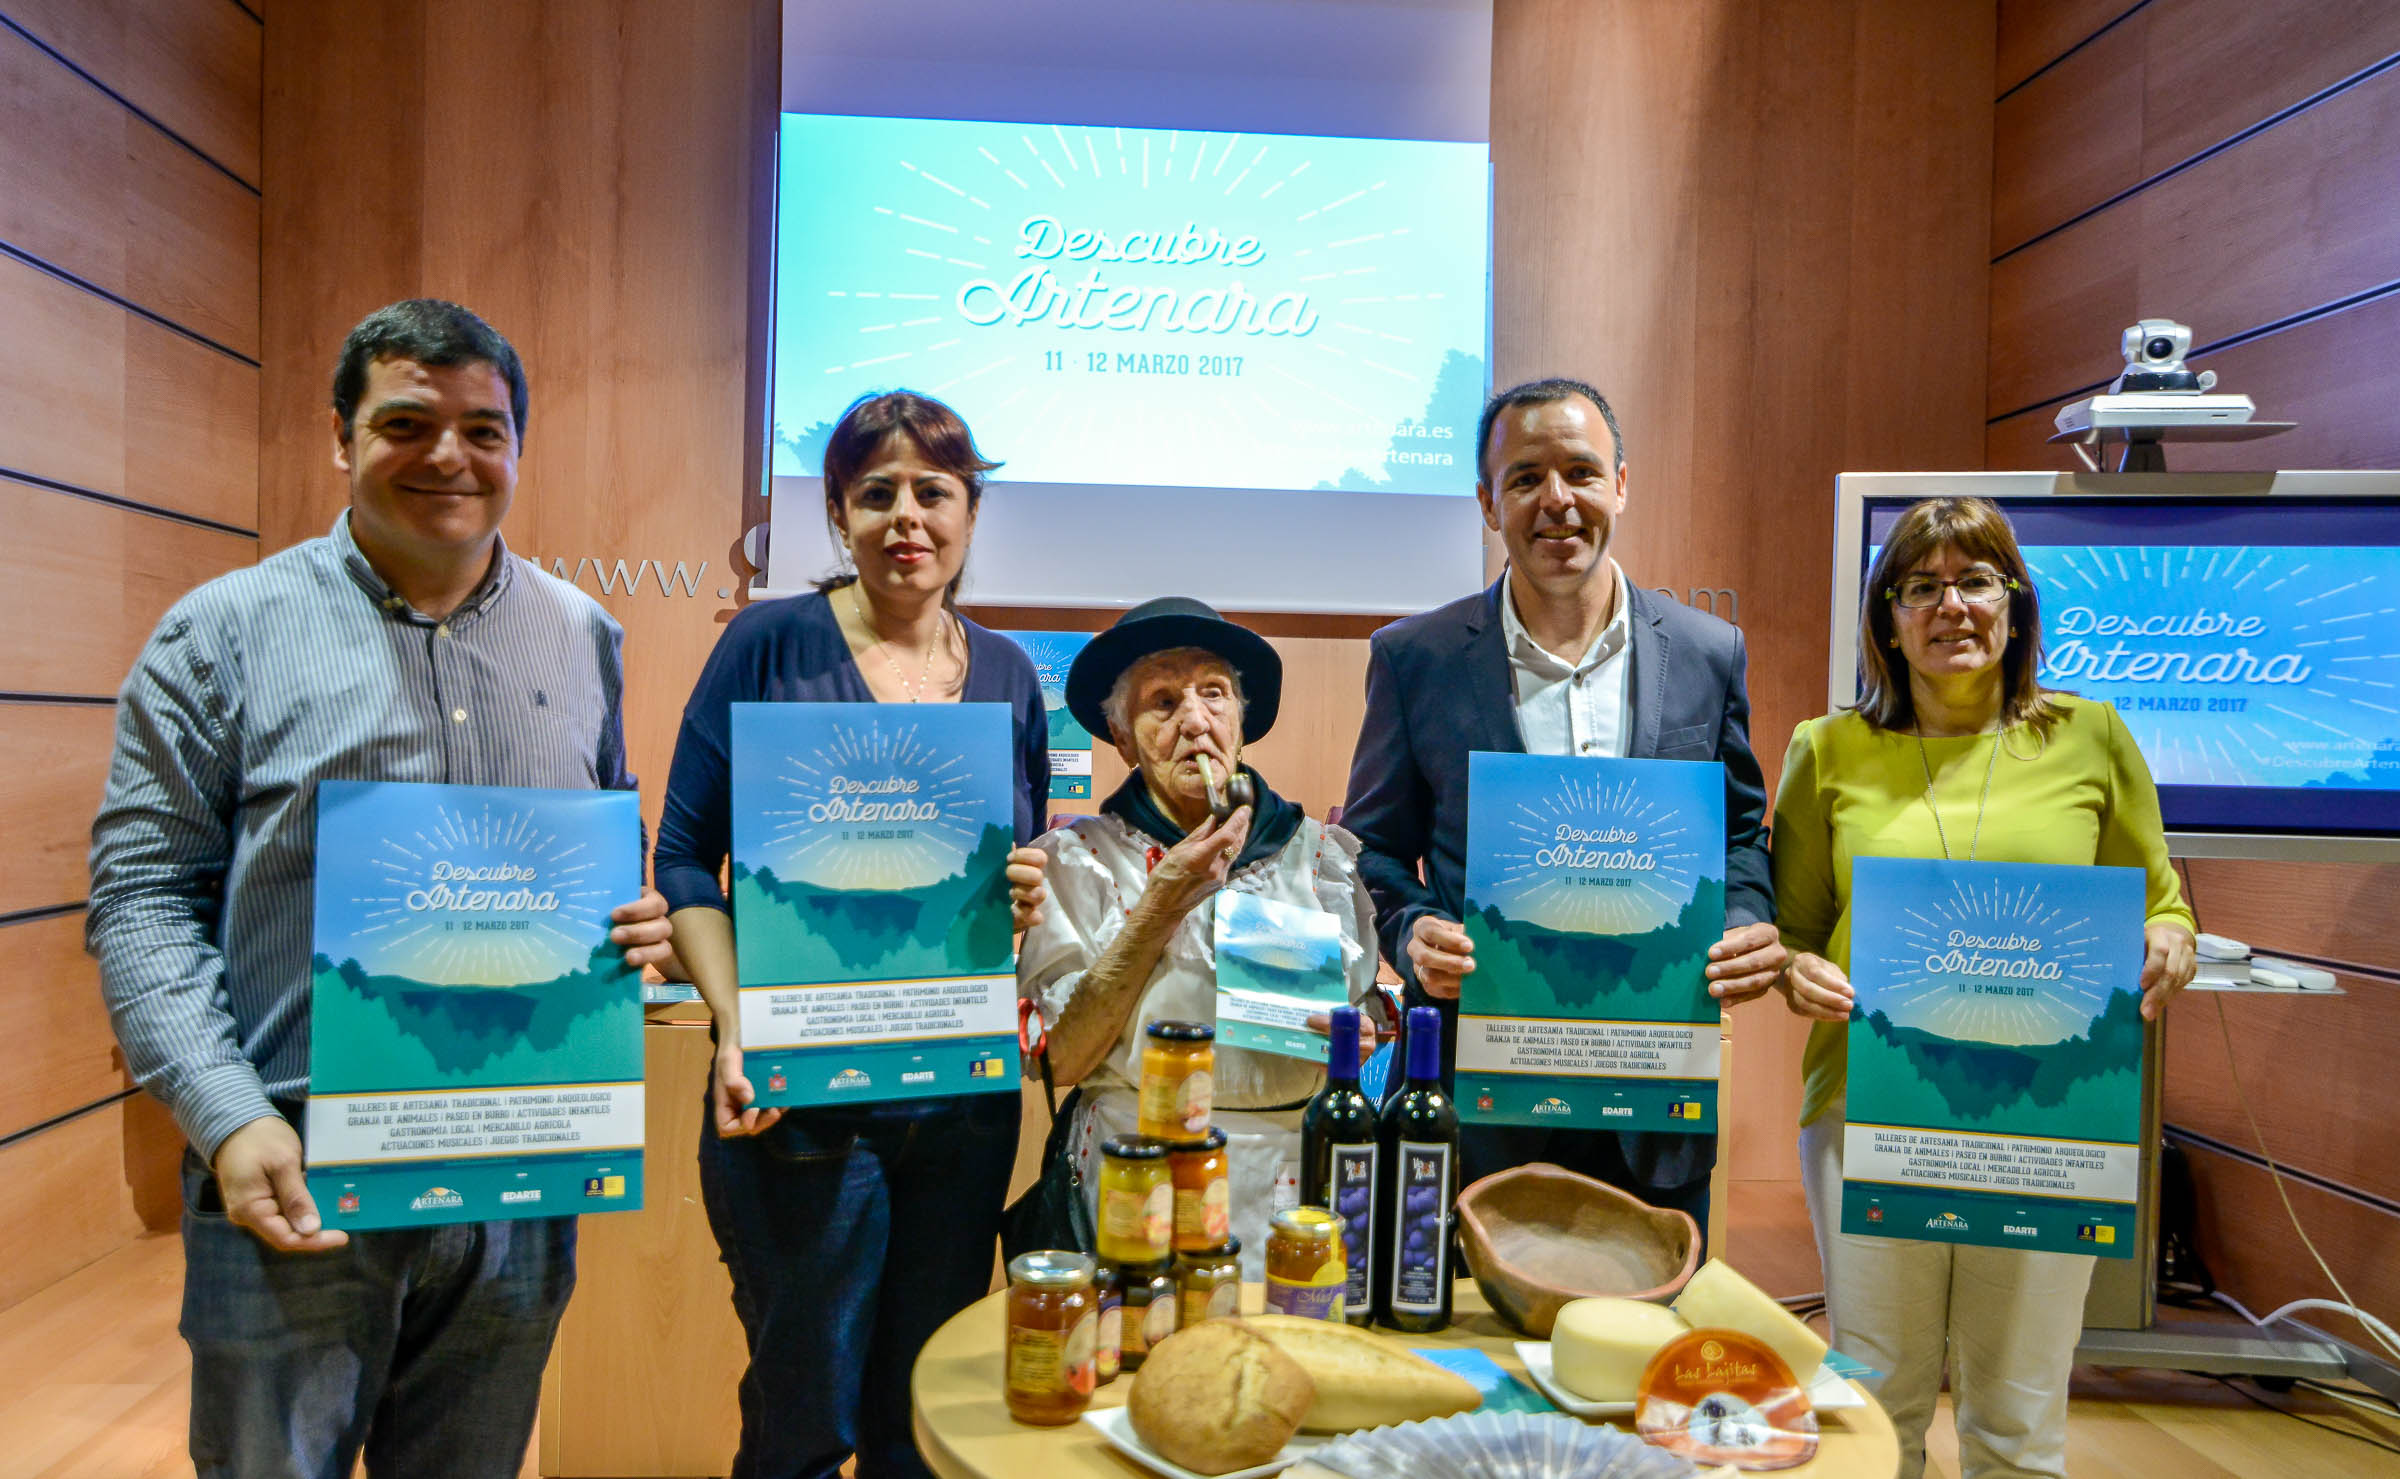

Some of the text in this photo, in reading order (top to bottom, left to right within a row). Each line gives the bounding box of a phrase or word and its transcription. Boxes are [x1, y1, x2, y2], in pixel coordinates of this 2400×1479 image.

[1014, 214, 1266, 266] Descubre
[956, 265, 1319, 336] Artenara
[1045, 351, 1244, 376] 11 12 MARZO 2017
[2056, 606, 2266, 640] Descubre
[2038, 641, 2312, 685] Artenara
[2114, 696, 2248, 712] 12 MARZO 2017
[829, 776, 920, 794] Descubre
[808, 796, 940, 823] Artenara
[842, 832, 849, 840] 11
[1555, 824, 1638, 843] Descubre
[1536, 844, 1656, 871] Artenara
[432, 861, 536, 882] Descubre
[1579, 878, 1586, 886] 12
[1589, 878, 1614, 886] MARZO
[1616, 878, 1632, 887] 2017
[407, 884, 560, 911] Artenara
[446, 921, 454, 930] 11
[1947, 929, 2042, 952] Descubre
[1925, 950, 2063, 980] Artenara
[1958, 984, 2034, 996] 11 12 MARZO 2017
[1486, 1024, 1515, 1032] TALLERES
[1565, 1027, 1604, 1035] TRADICIONAL
[1610, 1028, 1646, 1037] PATRIMONIO
[1485, 1034, 1510, 1043] GRANJA
[1522, 1036, 1554, 1044] ANIMALES
[1616, 1039, 1655, 1048] ACTIVIDADES
[1657, 1040, 1691, 1049] INFANTILES
[1510, 1057, 1551, 1066] ACTUACIONES
[1553, 1059, 1588, 1067] MUSICALES
[1619, 1061, 1666, 1069] TRADICIONALES
[1588, 1049, 1627, 1057] MERCADILLO
[1602, 1107, 1632, 1116] EDARTE
[1874, 1132, 1906, 1142] TALLERES
[1961, 1139, 2004, 1150] TRADICIONAL
[2011, 1143, 2052, 1154] PATRIMONIO
[1874, 1143, 1901, 1153] GRANJA
[1903, 1146, 1911, 1154] DE
[1914, 1146, 1949, 1157] ANIMALES
[1955, 1150, 1976, 1159] PASEO
[1989, 1153, 2011, 1162] BURRO
[2018, 1155, 2062, 1166] ACTIVIDADES
[2065, 1158, 2104, 1169] INFANTILES
[1959, 1161, 1981, 1170] LOCAL
[1987, 1164, 2030, 1174] MERCADILLO
[1901, 1168, 2075, 1189] ACTUACIONES MUSICALES JUEGOS TRADICIONALES
[502, 1190, 541, 1202] EDARTE
[1926, 1216, 2038, 1236] ARTENARA EDARTE
